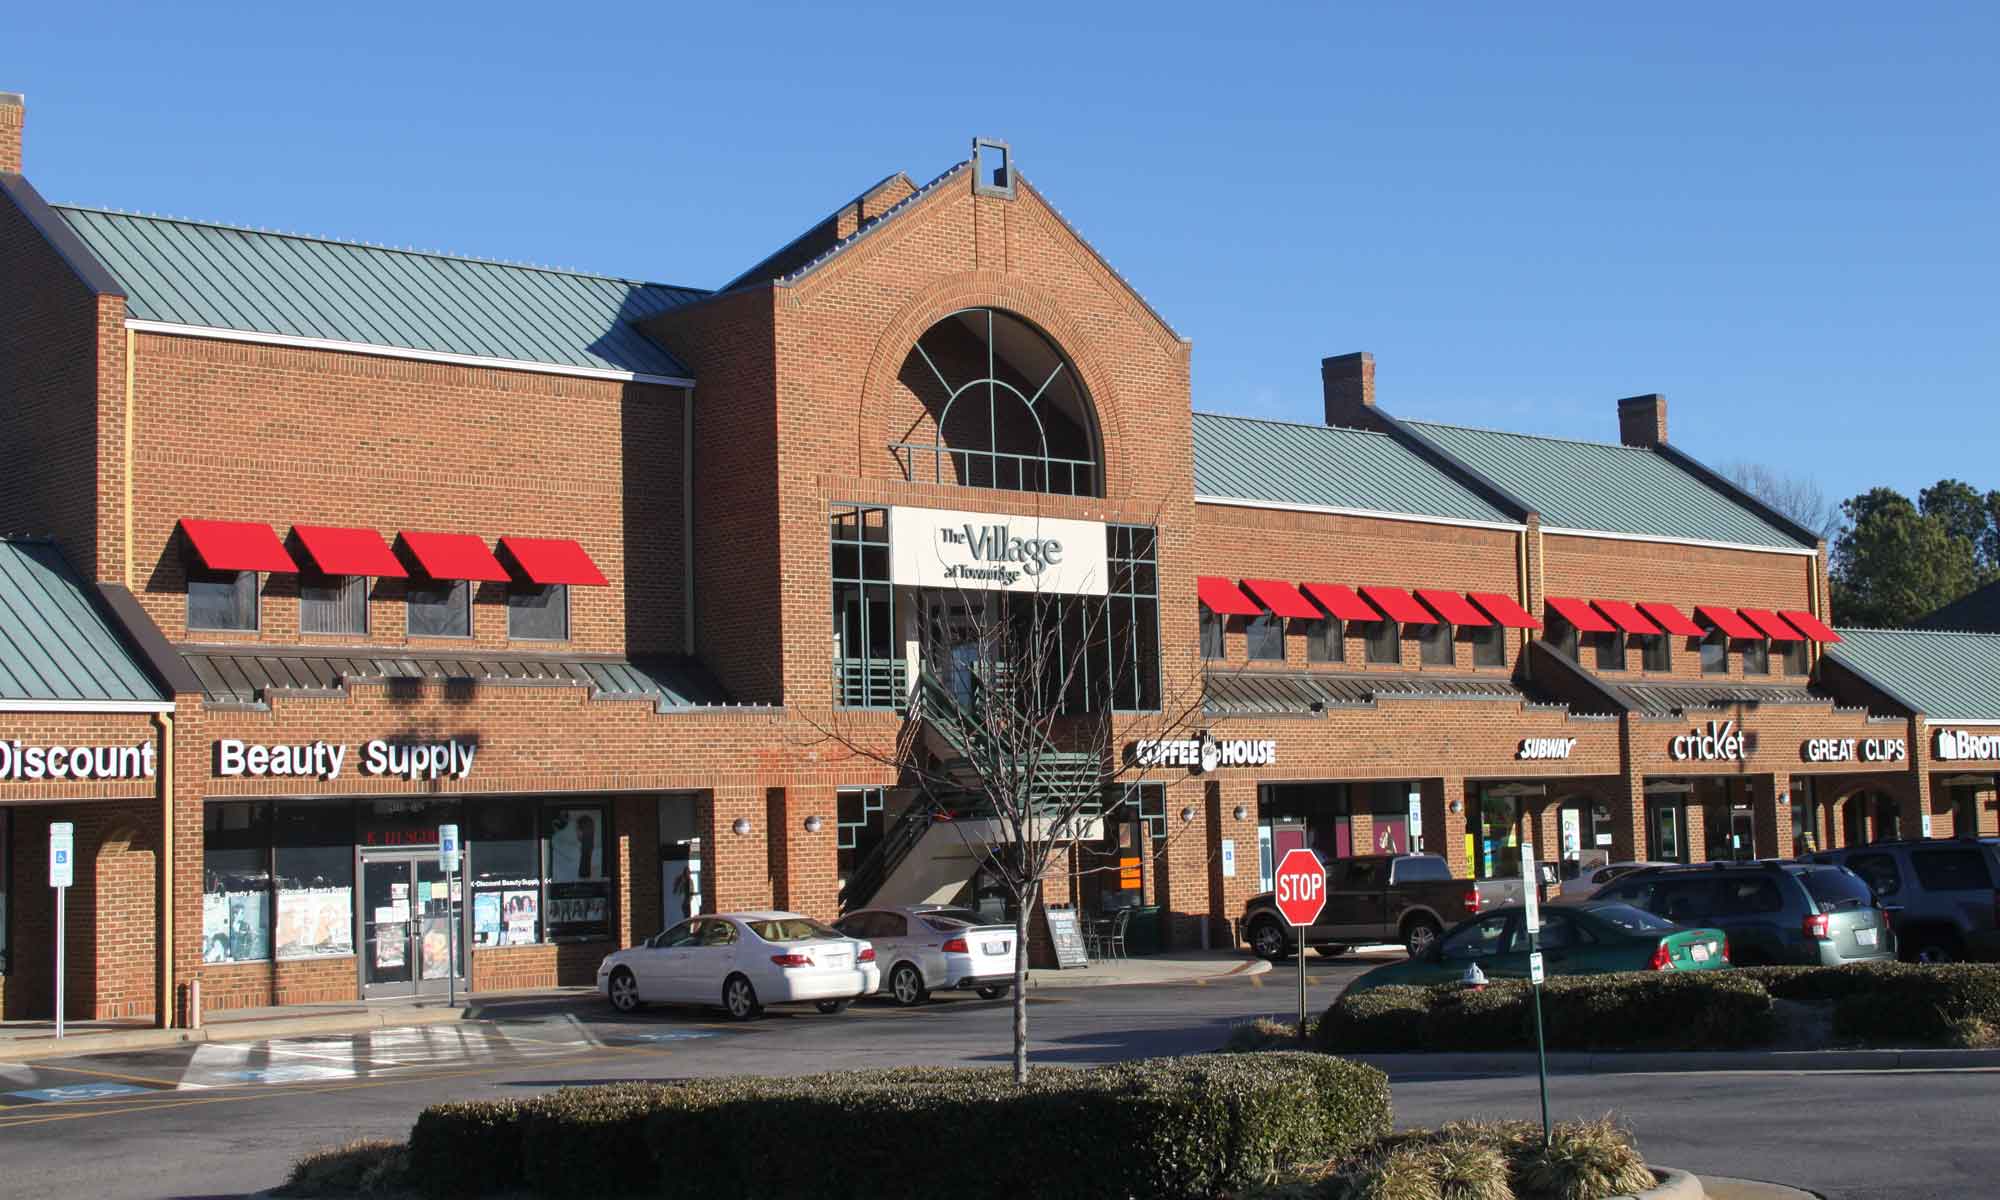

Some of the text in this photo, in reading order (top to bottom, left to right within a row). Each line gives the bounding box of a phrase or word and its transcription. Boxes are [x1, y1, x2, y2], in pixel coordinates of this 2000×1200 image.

[940, 523, 1063, 575] The Village
[1136, 739, 1276, 765] COFFEE HOUSE
[1520, 737, 1577, 759] SUBWAY
[1673, 720, 1745, 760] cricket
[1808, 738, 1905, 761] GREAT CLIPS
[220, 739, 346, 780] Beauty
[366, 739, 475, 780] Supply
[1280, 873, 1322, 902] STOP
